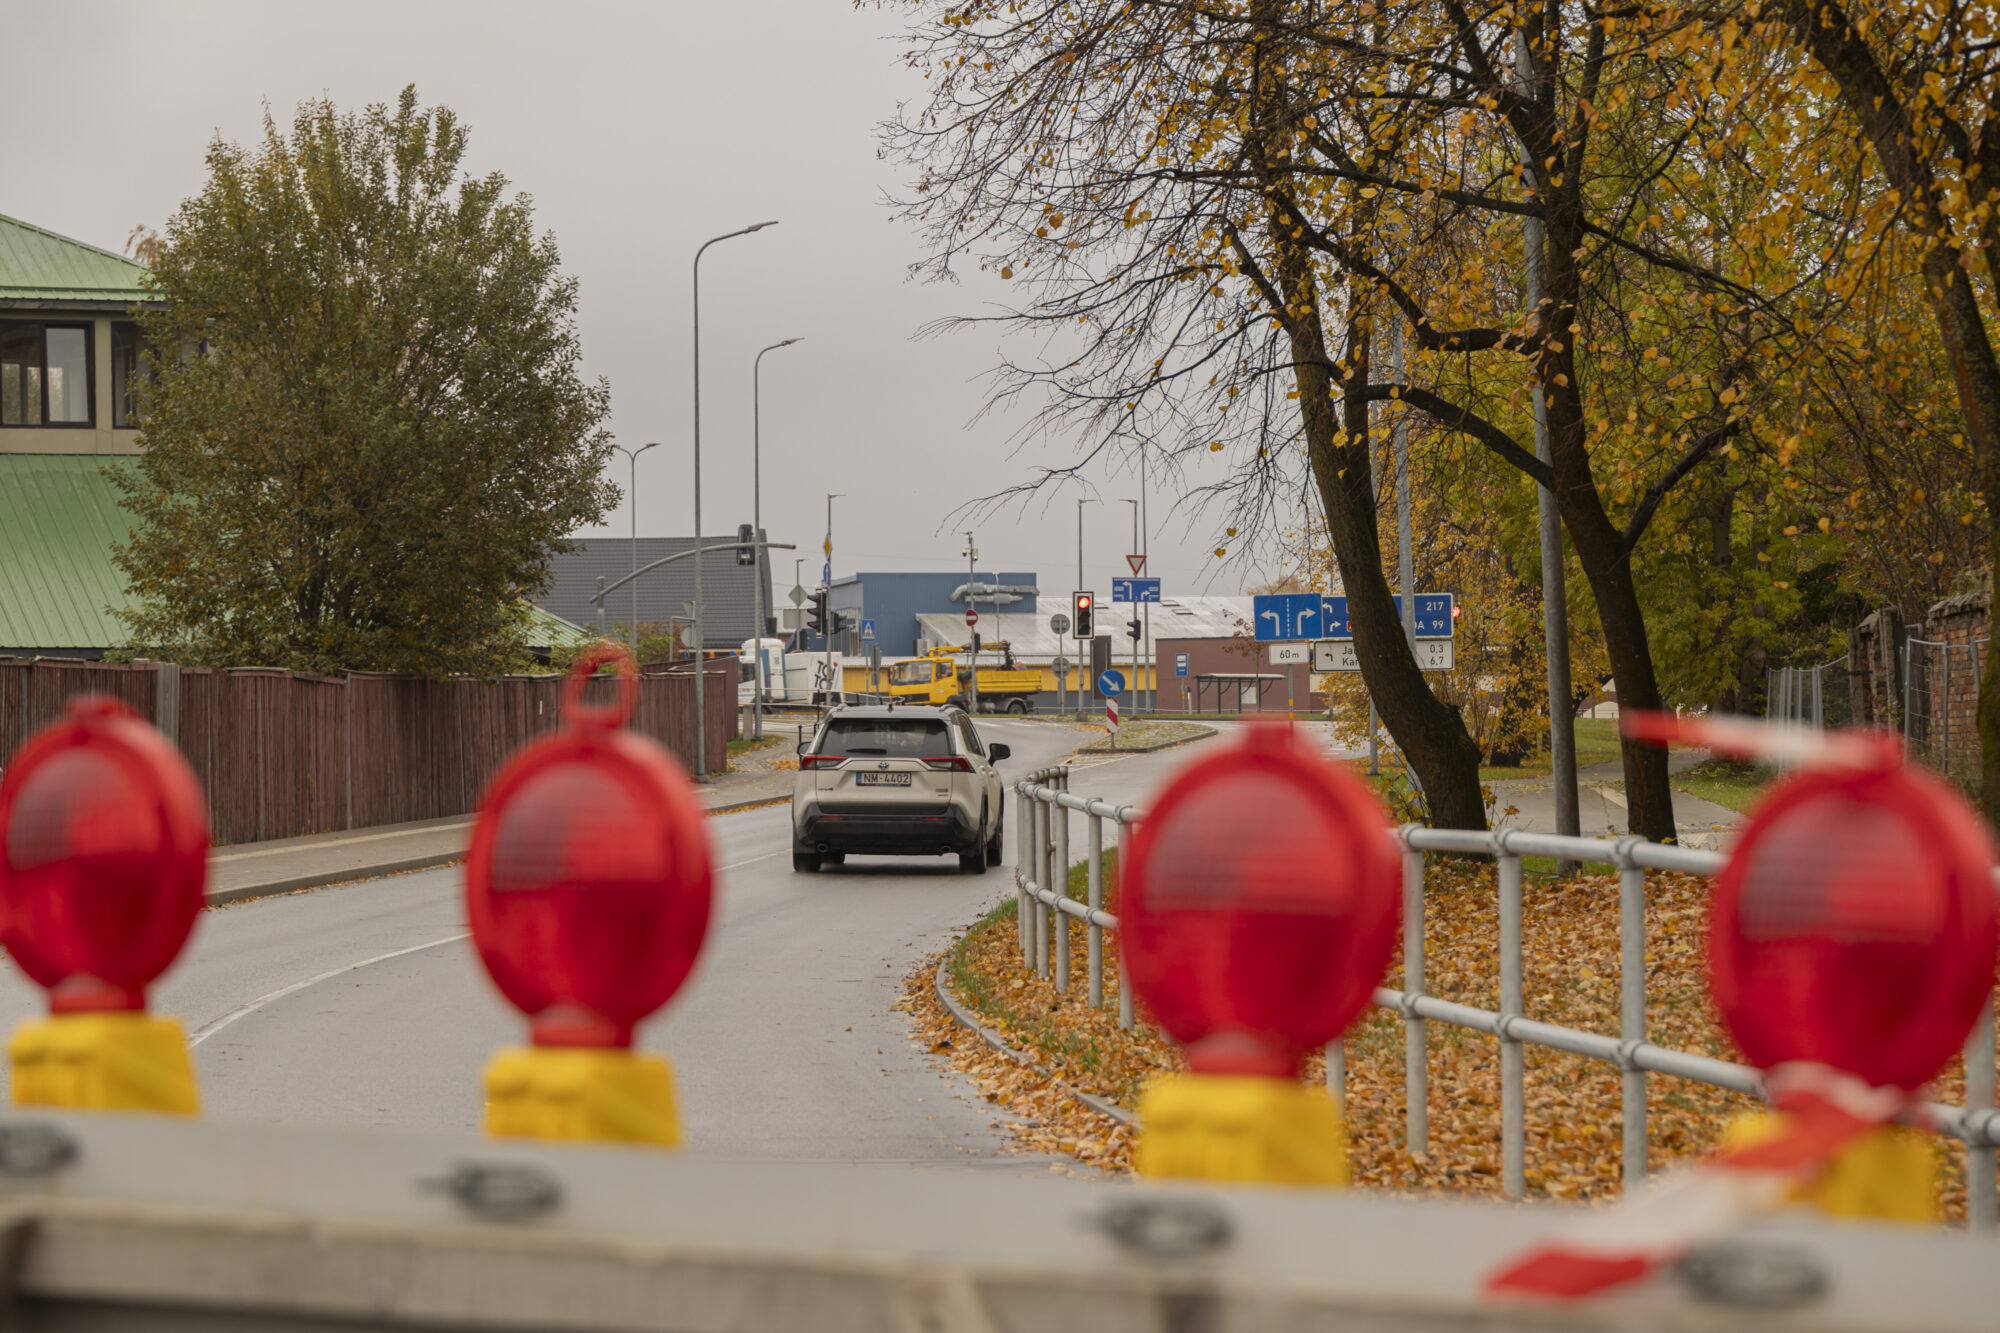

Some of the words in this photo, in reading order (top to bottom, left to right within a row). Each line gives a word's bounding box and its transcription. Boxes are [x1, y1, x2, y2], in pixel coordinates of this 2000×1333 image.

[1426, 601, 1444, 611] 217
[1432, 620, 1444, 630] 99
[1279, 649, 1291, 659] 60
[863, 773, 909, 784] NM-4402
